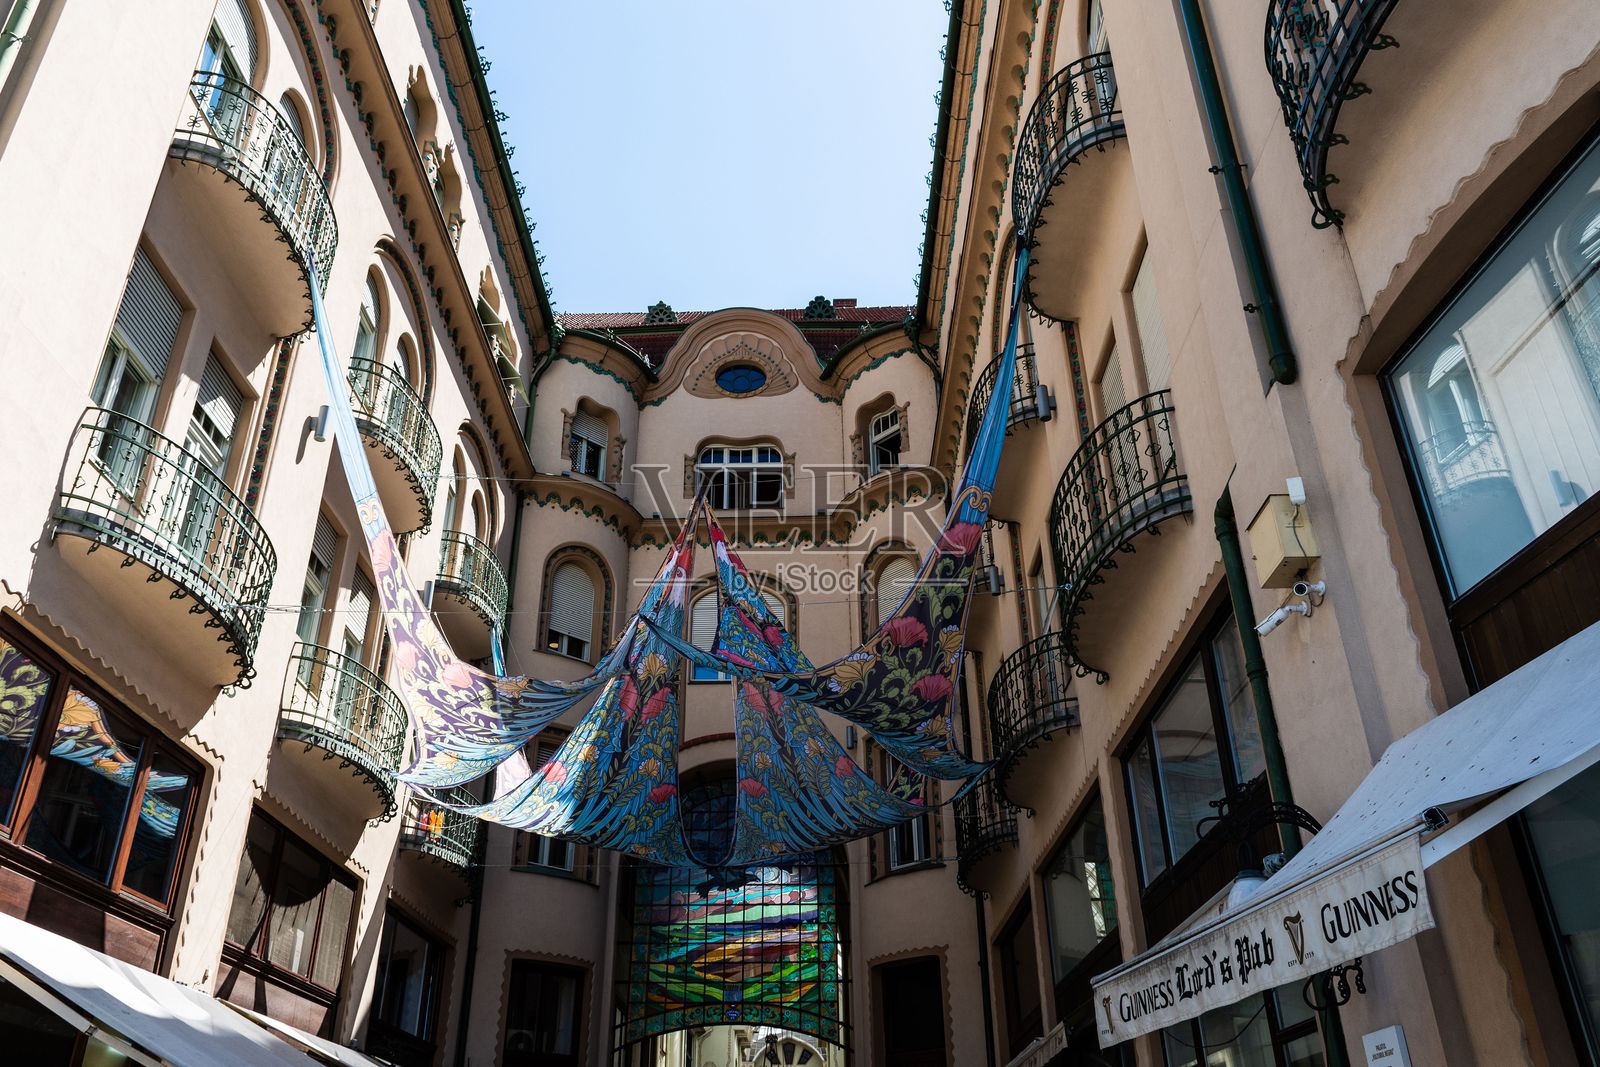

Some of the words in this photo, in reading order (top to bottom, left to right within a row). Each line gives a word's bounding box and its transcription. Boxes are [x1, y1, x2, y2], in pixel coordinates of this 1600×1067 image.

[1320, 870, 1418, 944] GUINNESS
[1119, 979, 1174, 1023] GUINNESS
[1175, 949, 1233, 1001] Lord's
[1235, 928, 1274, 985] Pub
